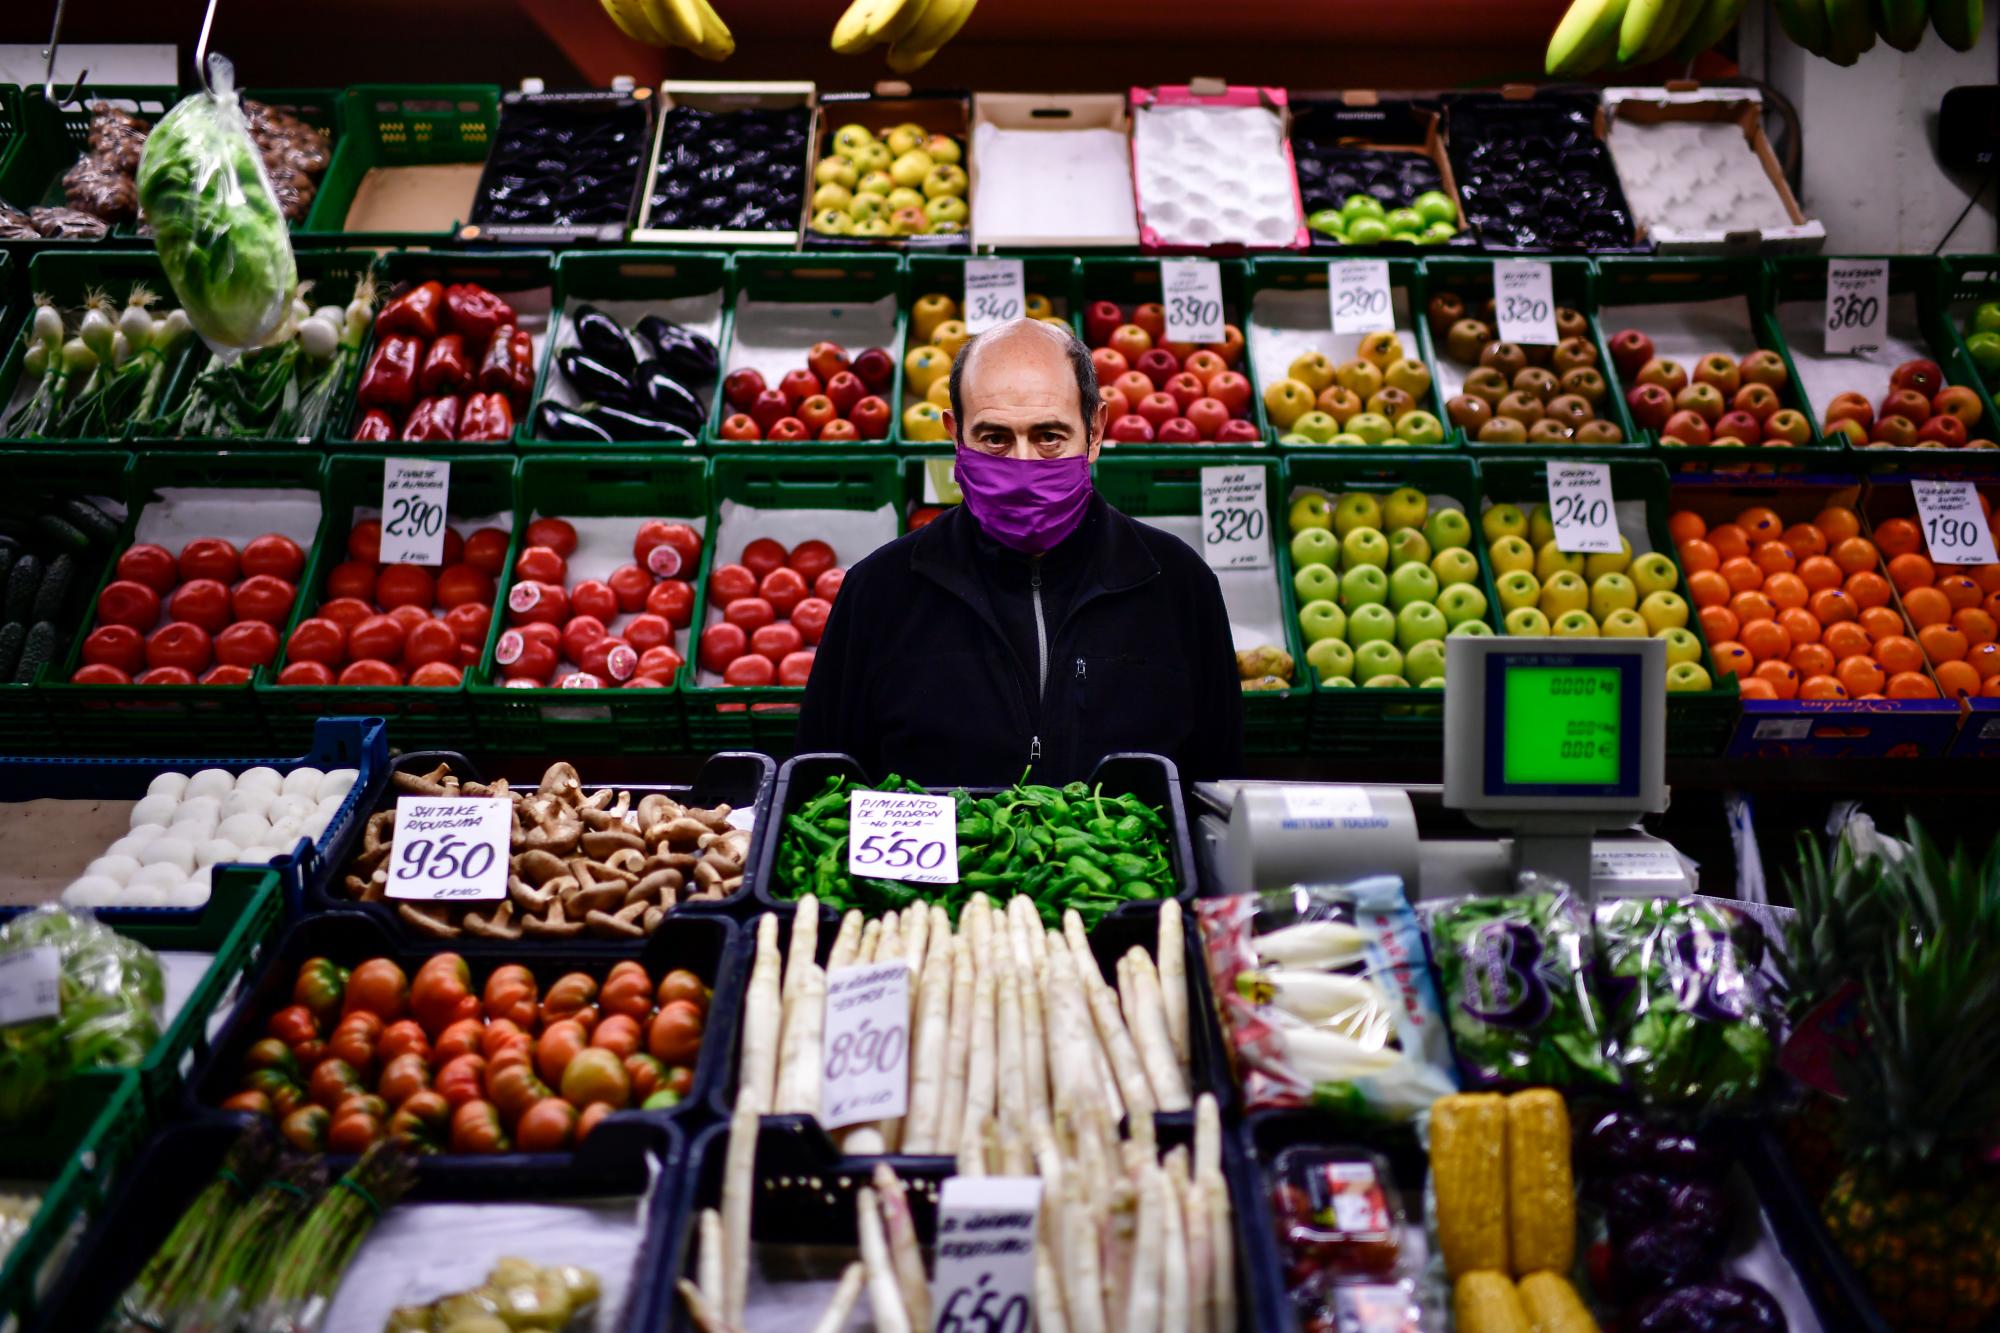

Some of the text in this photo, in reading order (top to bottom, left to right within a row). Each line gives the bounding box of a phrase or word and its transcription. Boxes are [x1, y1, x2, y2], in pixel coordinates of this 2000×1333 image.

[860, 799, 938, 808] PIMIENTO
[409, 805, 480, 818] SHITAKE
[857, 809, 943, 818] DE PADRON
[404, 816, 483, 832] RIQUISIMA
